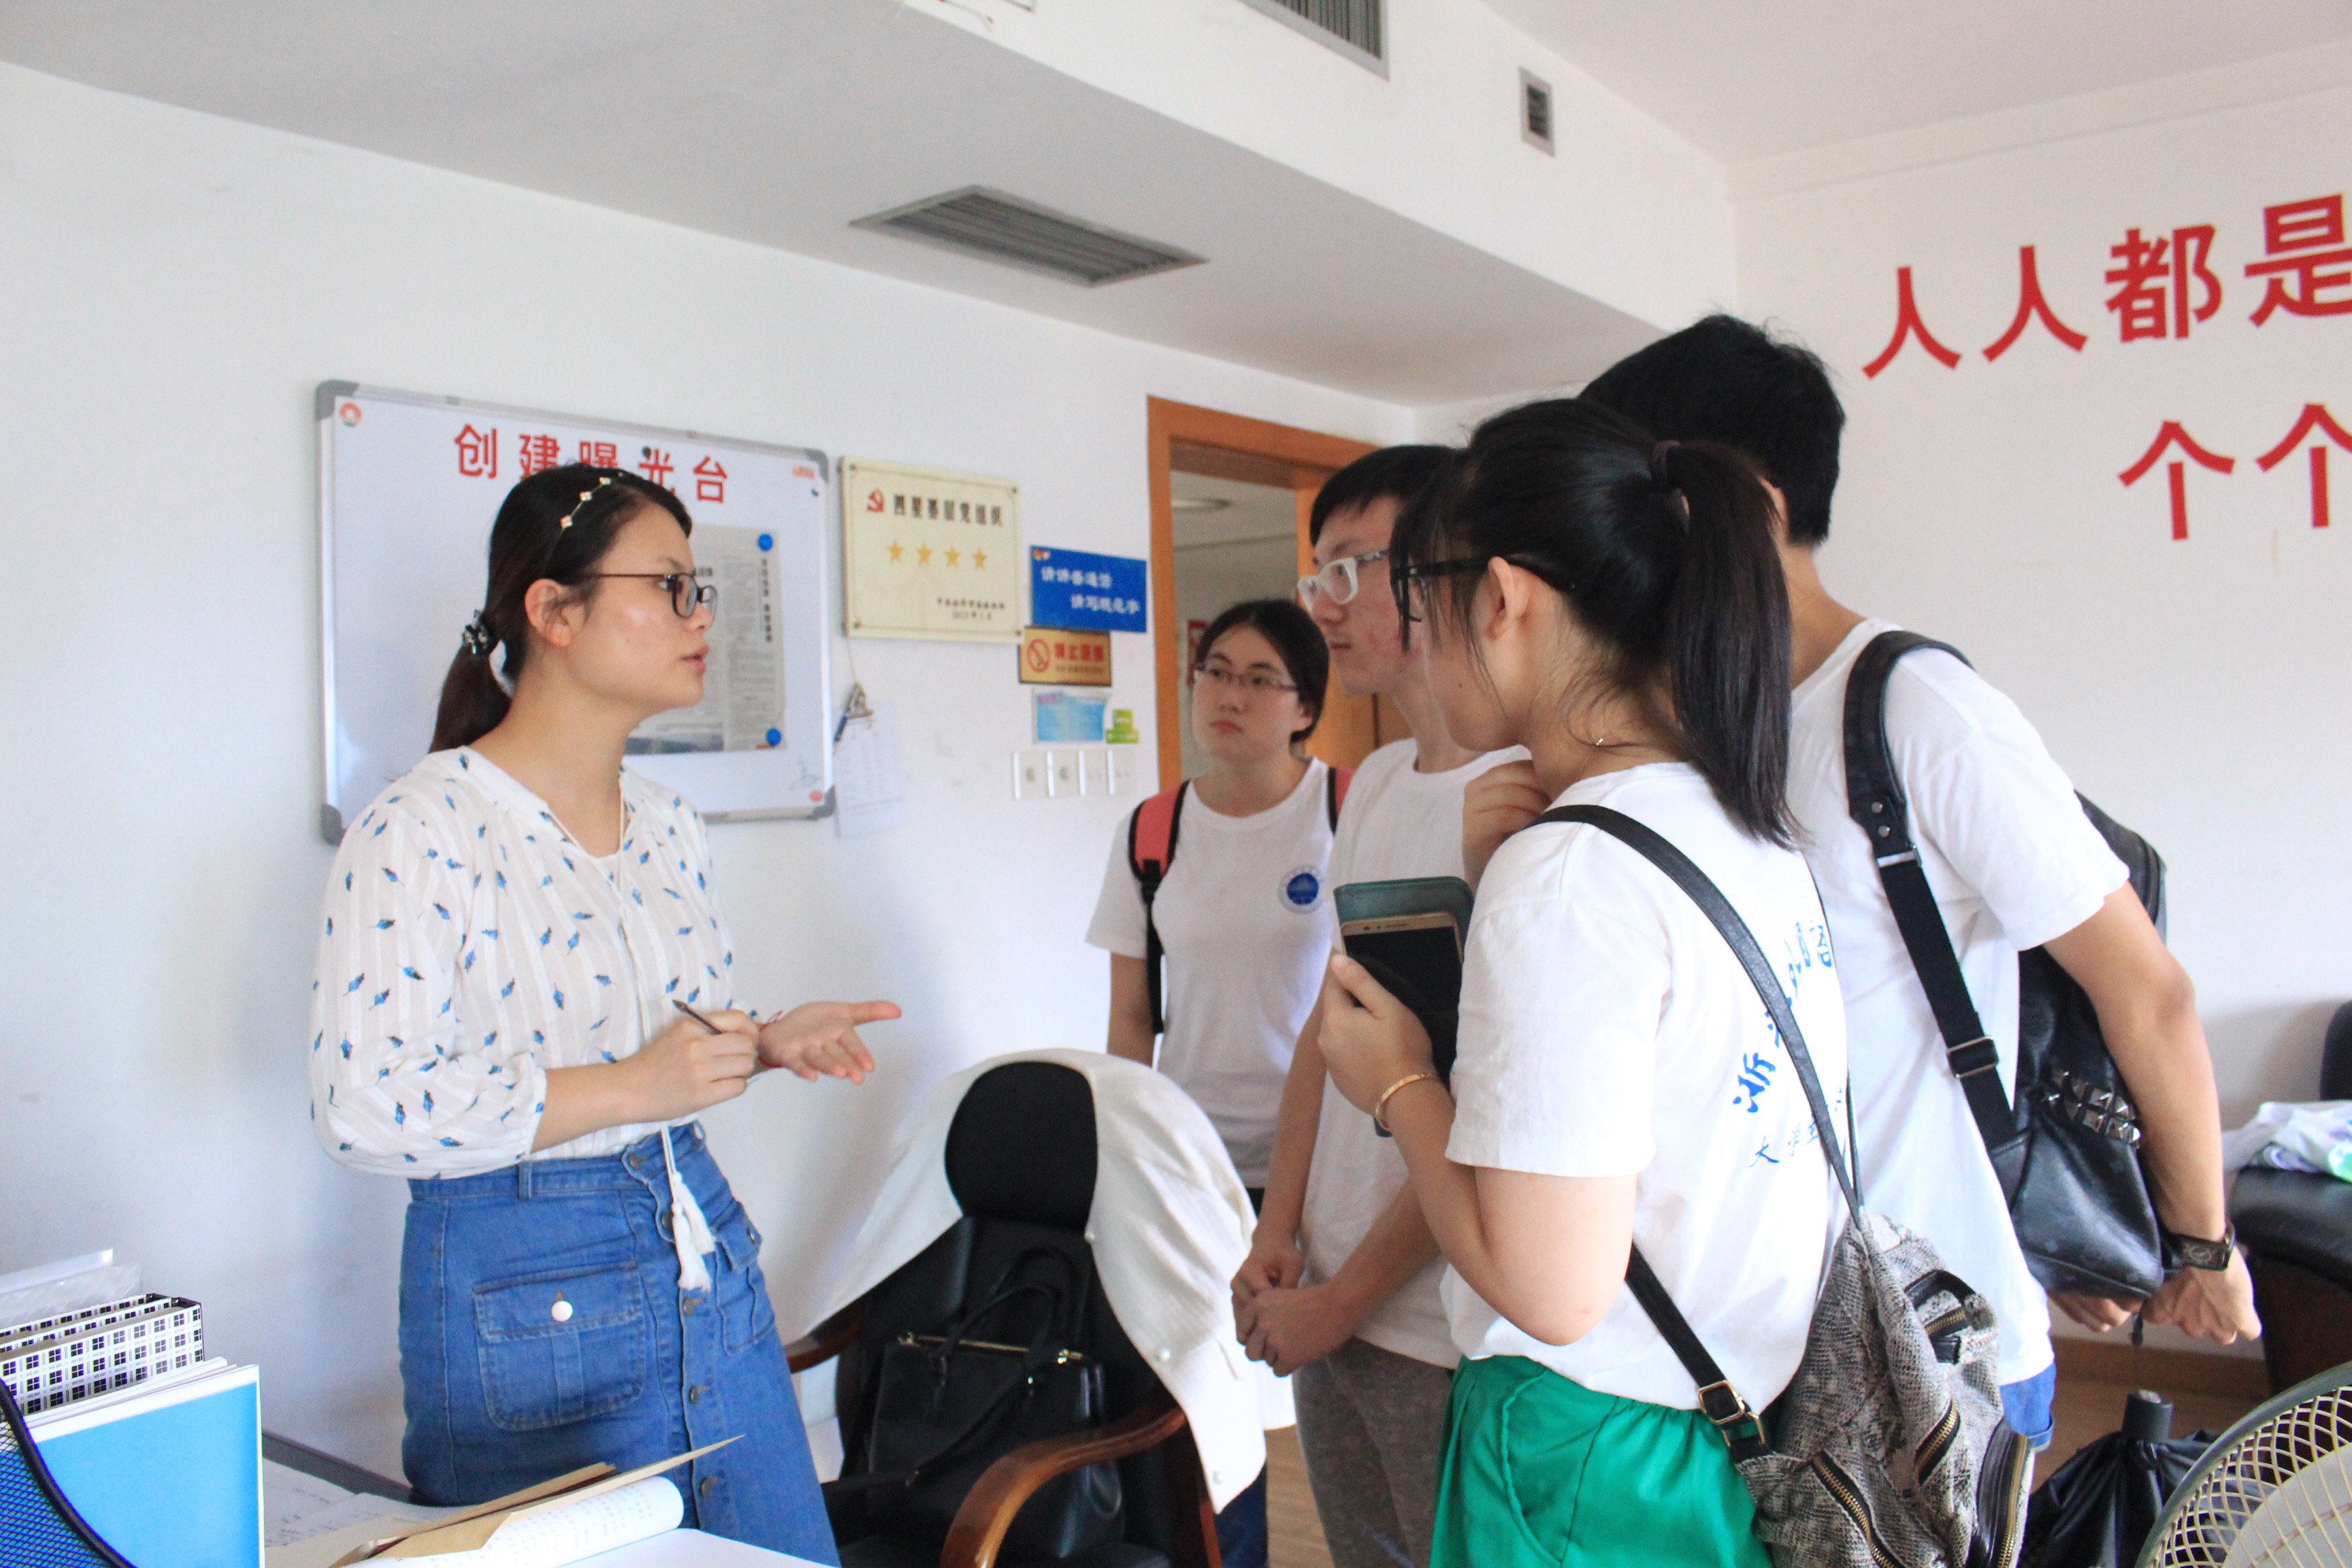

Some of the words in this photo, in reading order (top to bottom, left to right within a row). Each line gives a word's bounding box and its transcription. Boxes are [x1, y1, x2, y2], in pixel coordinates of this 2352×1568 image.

[1861, 193, 2352, 379] 人人都是
[2117, 402, 2352, 540] 个个
